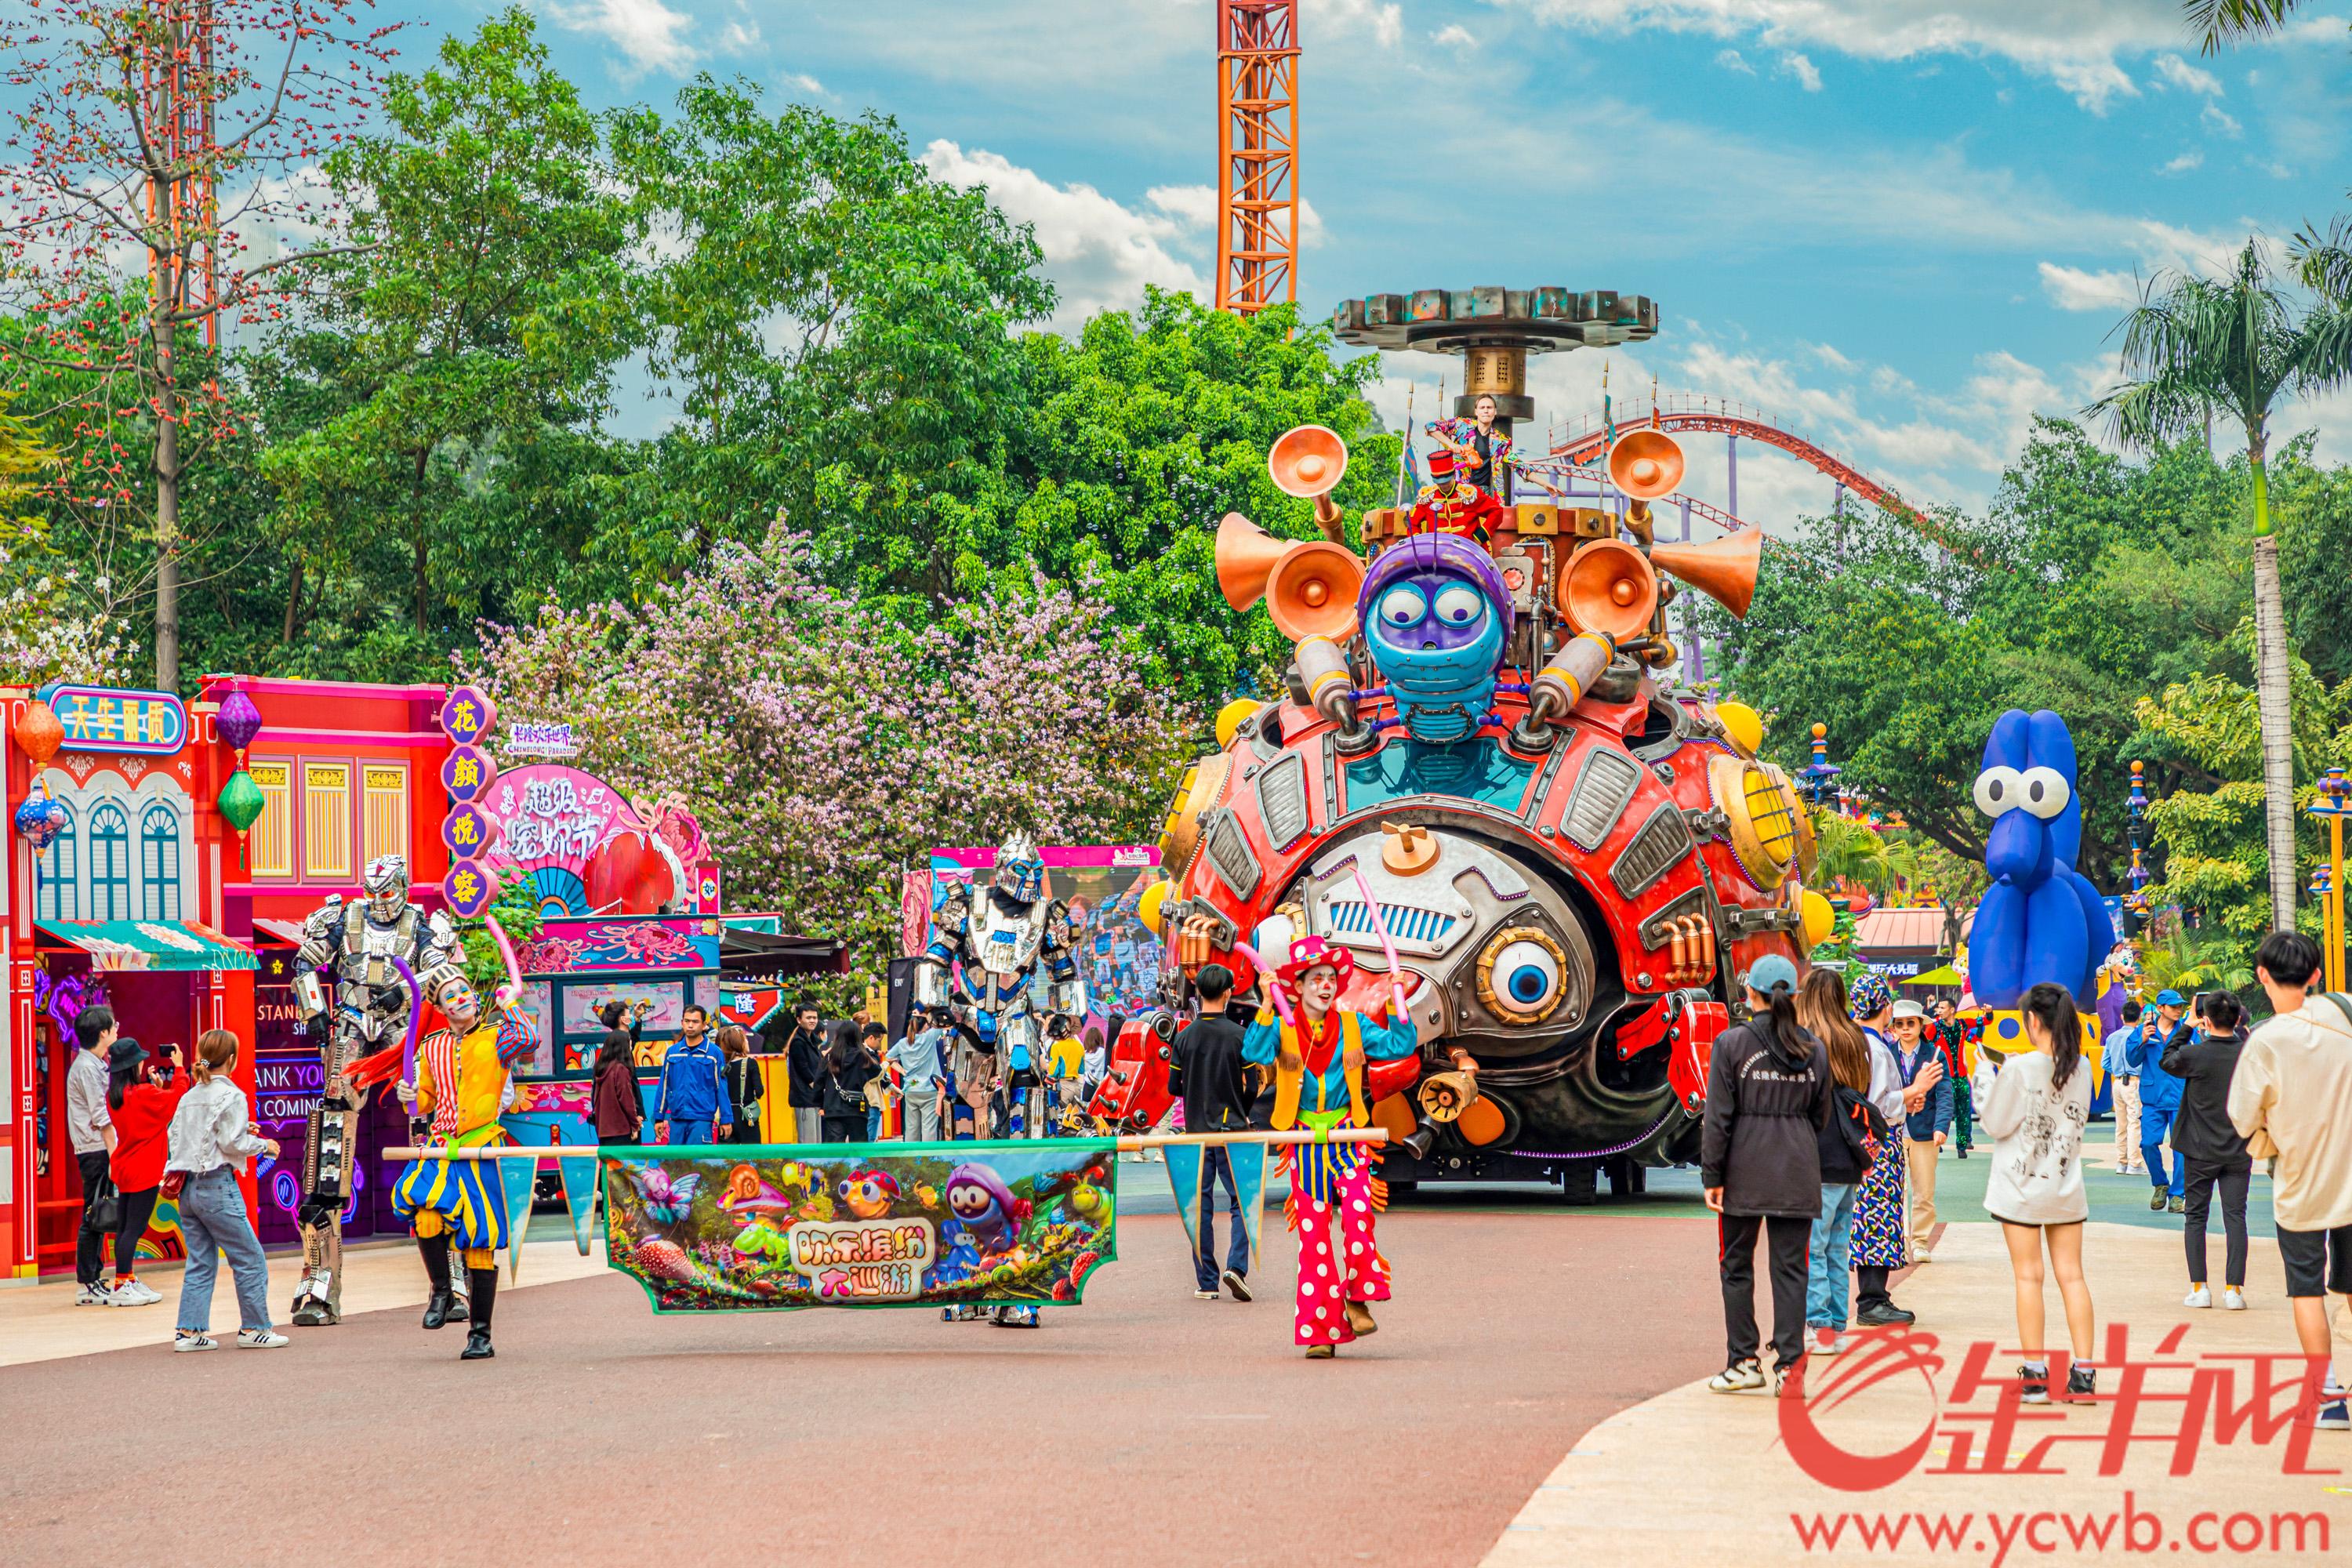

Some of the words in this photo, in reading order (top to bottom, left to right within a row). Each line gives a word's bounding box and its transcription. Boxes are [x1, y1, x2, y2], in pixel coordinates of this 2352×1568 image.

[72, 695, 166, 743] 天生丽质
[514, 725, 571, 746] 长隆欢乐世界
[451, 699, 480, 903] 花颜悦容
[524, 777, 583, 818] 超级
[734, 993, 757, 1014] 隆
[797, 1226, 926, 1265] 欢乐缤纷
[819, 1263, 912, 1297] 大巡游
